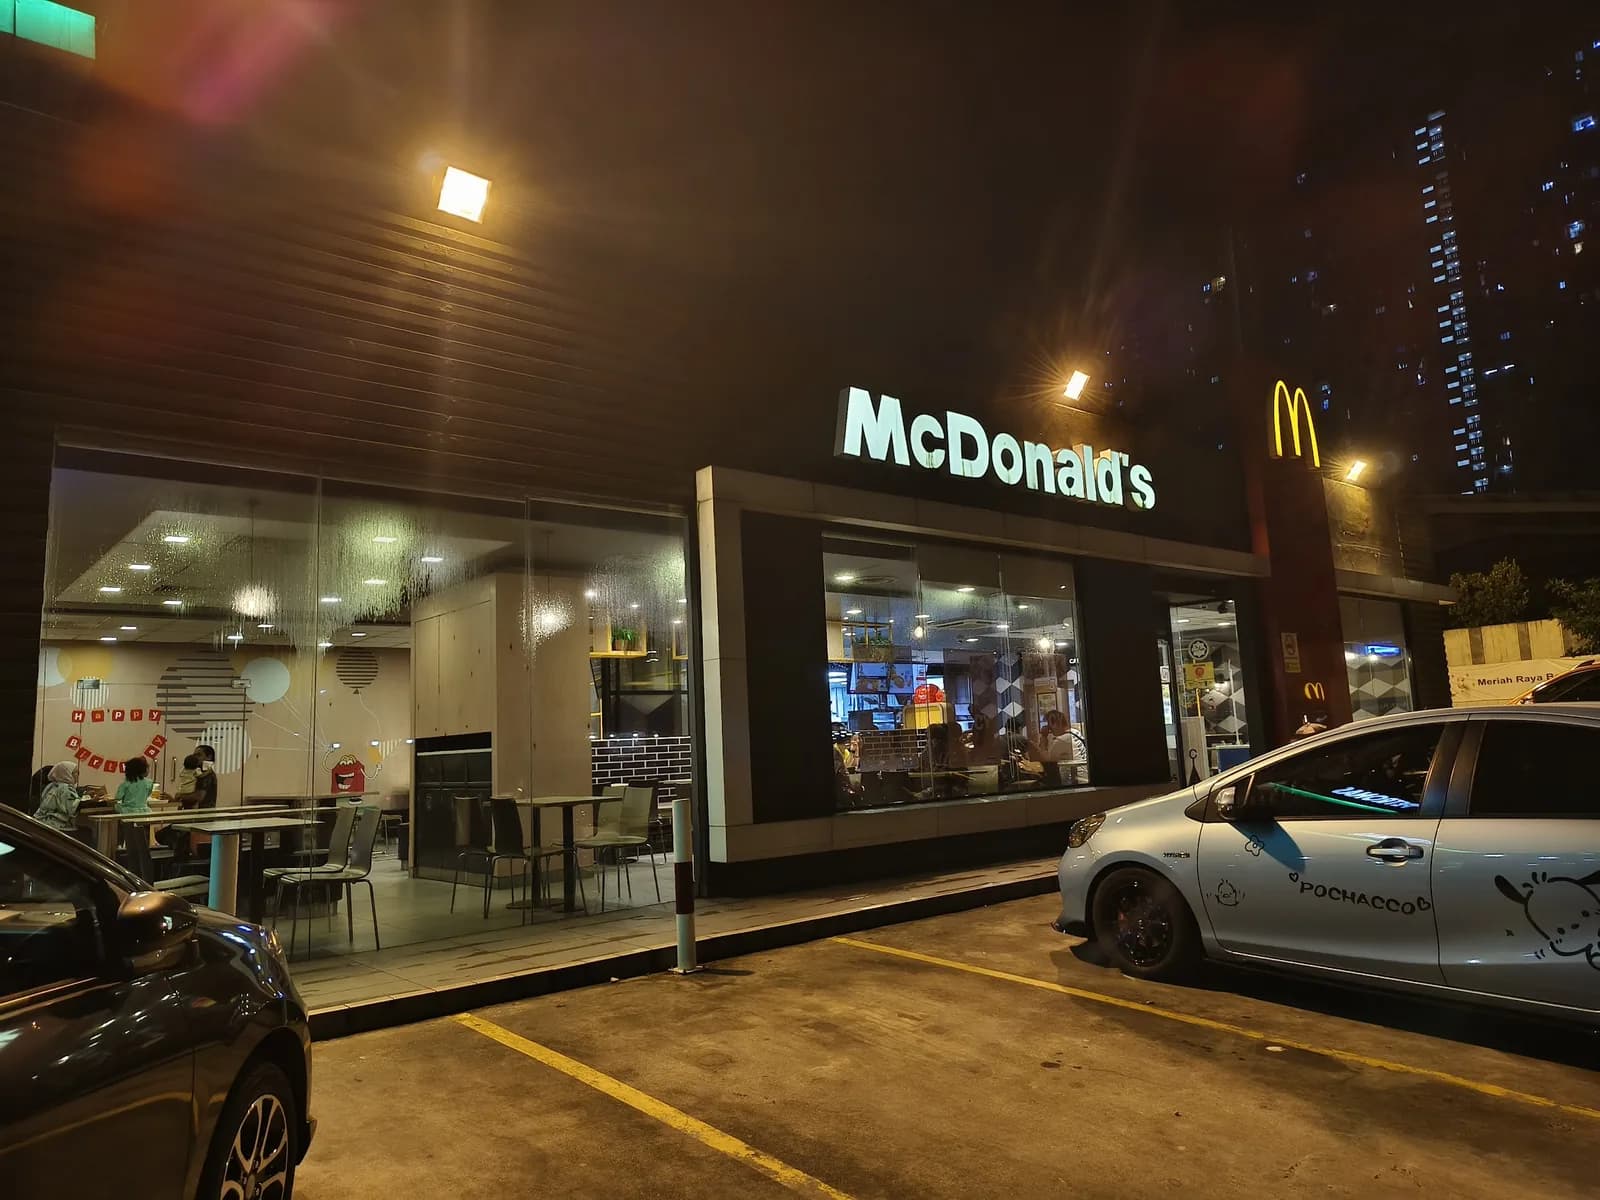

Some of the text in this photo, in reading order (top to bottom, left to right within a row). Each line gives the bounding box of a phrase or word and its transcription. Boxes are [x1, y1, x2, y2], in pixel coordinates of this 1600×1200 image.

[843, 386, 1156, 510] McDonald's
[1477, 676, 1513, 686] Meriah
[1515, 674, 1543, 684] Raya
[1299, 881, 1416, 915] POCHACCO
